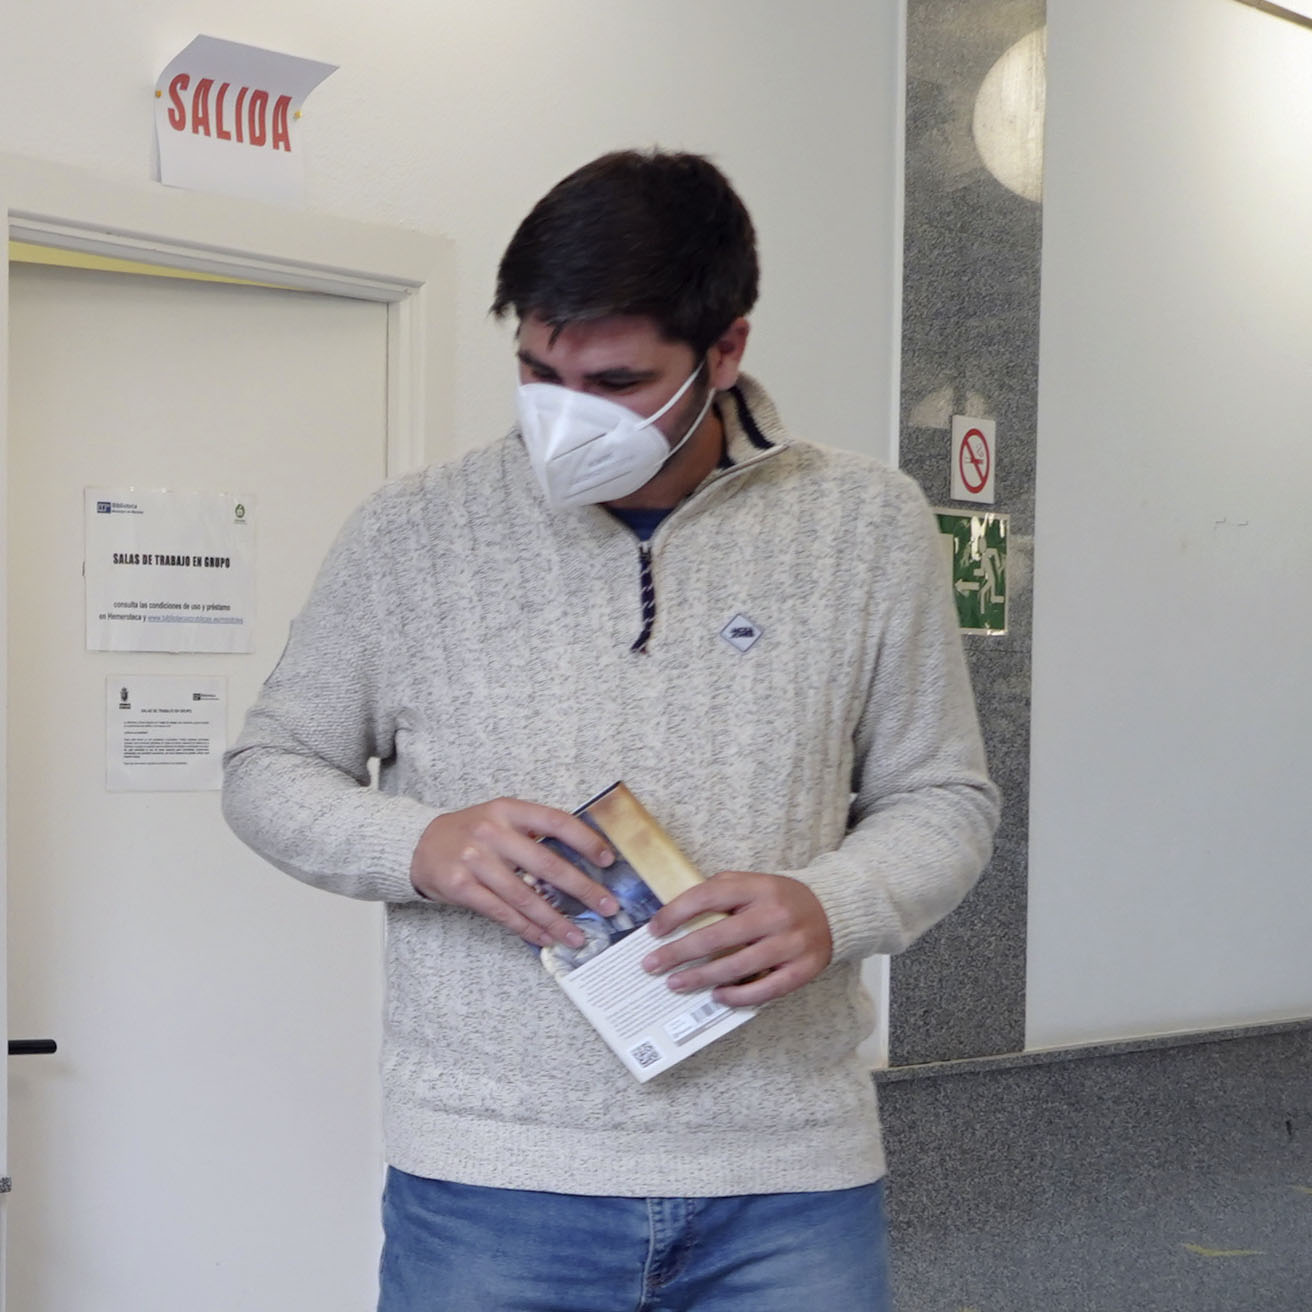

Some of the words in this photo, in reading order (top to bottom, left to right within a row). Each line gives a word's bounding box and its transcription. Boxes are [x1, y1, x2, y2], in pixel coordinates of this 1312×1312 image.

[167, 72, 294, 153] SALIDA
[113, 553, 140, 565] SALAS
[142, 554, 152, 565] DE
[155, 555, 190, 567] TRABAJO
[192, 556, 202, 567] EN
[204, 557, 230, 568] GRUPO
